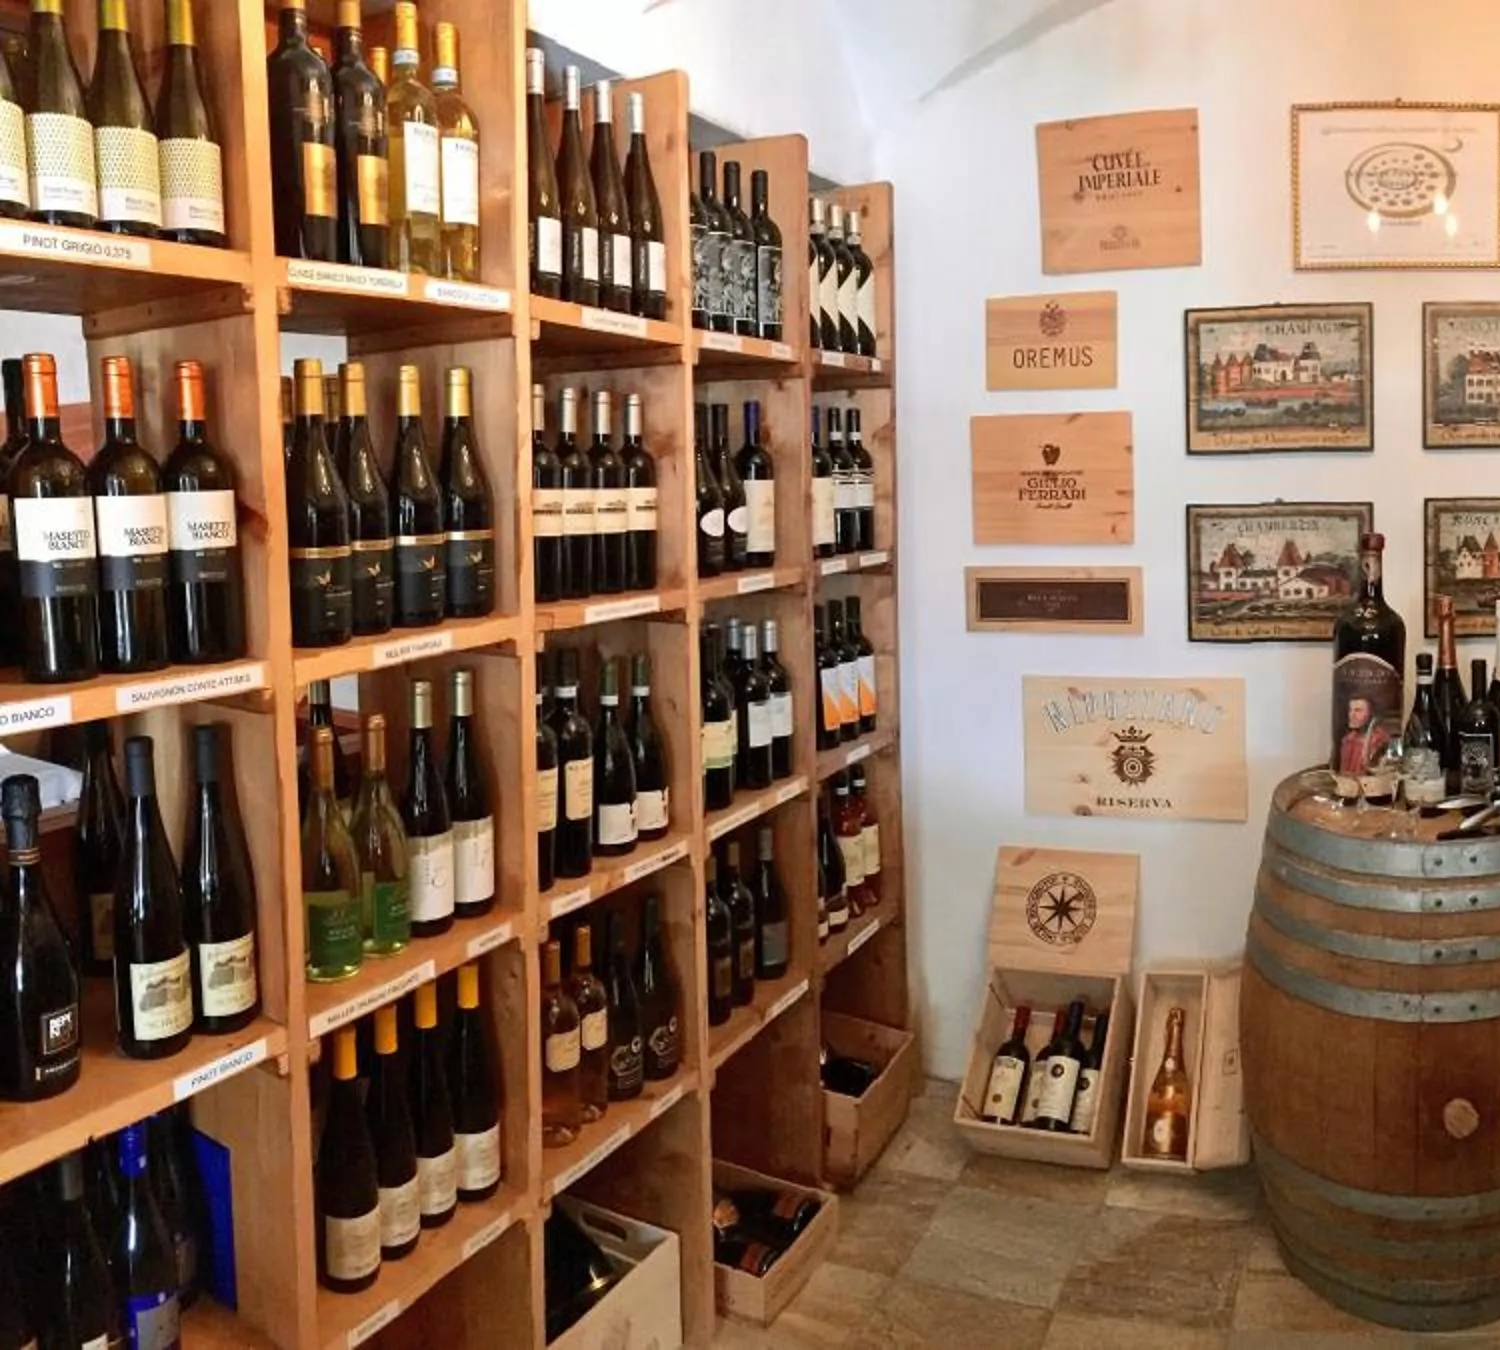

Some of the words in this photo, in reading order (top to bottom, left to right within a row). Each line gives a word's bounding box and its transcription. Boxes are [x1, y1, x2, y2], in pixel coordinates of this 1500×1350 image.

[1078, 168, 1162, 192] IMPERIALE
[22, 233, 58, 249] PINOT
[1013, 346, 1094, 369] OREMUS
[1018, 488, 1086, 501] FERRARI
[11, 706, 55, 724] BIANCO
[1095, 796, 1174, 809] RISERVA
